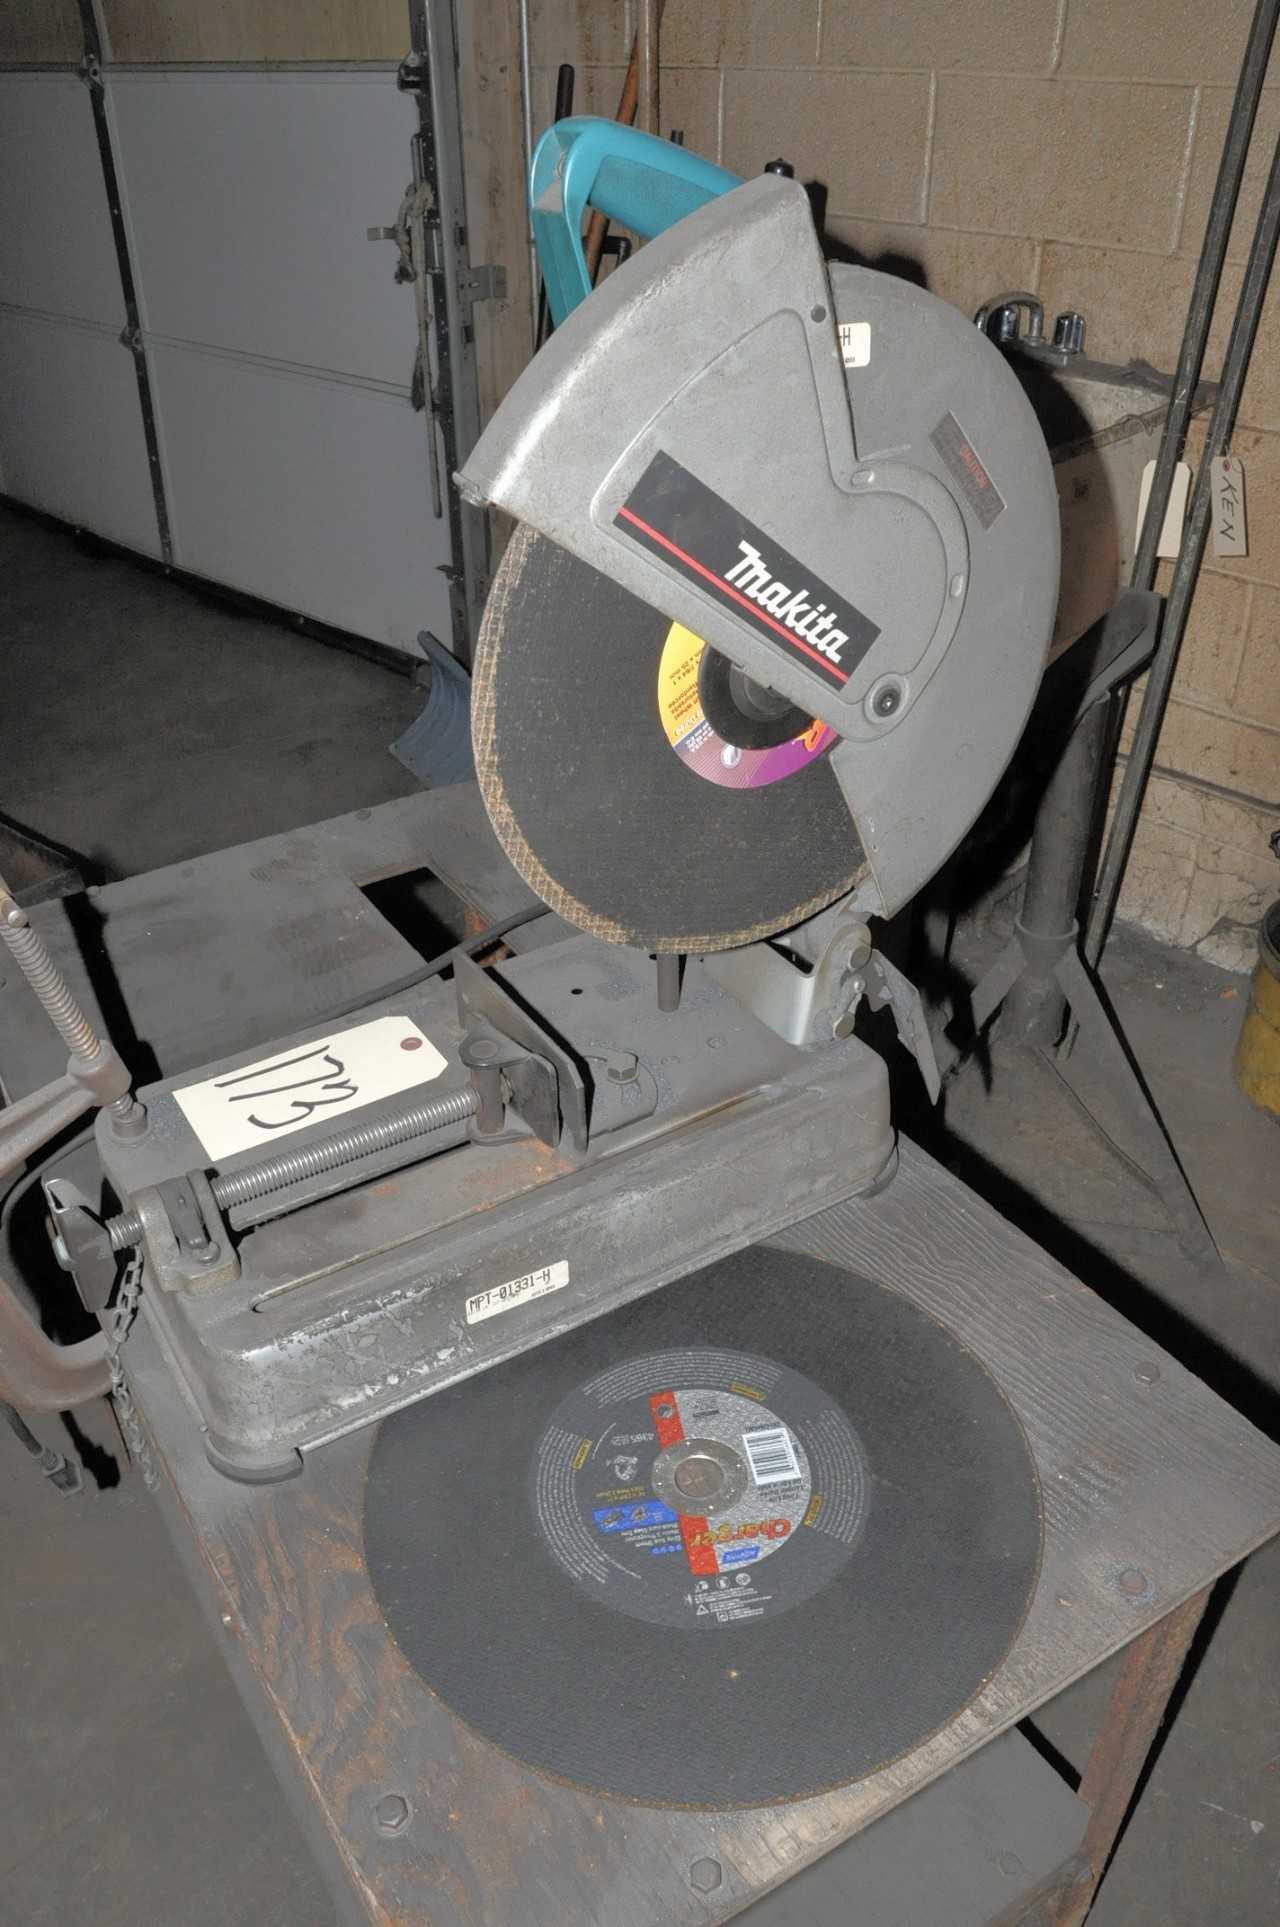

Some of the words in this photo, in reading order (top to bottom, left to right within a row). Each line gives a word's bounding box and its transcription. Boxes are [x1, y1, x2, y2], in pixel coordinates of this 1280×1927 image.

[1220, 476, 1239, 541] KEN
[723, 539, 849, 664] Makita
[214, 1045, 359, 1130] 173
[469, 1268, 551, 1312] MPT-01331-H
[690, 1518, 791, 1547] Charger
